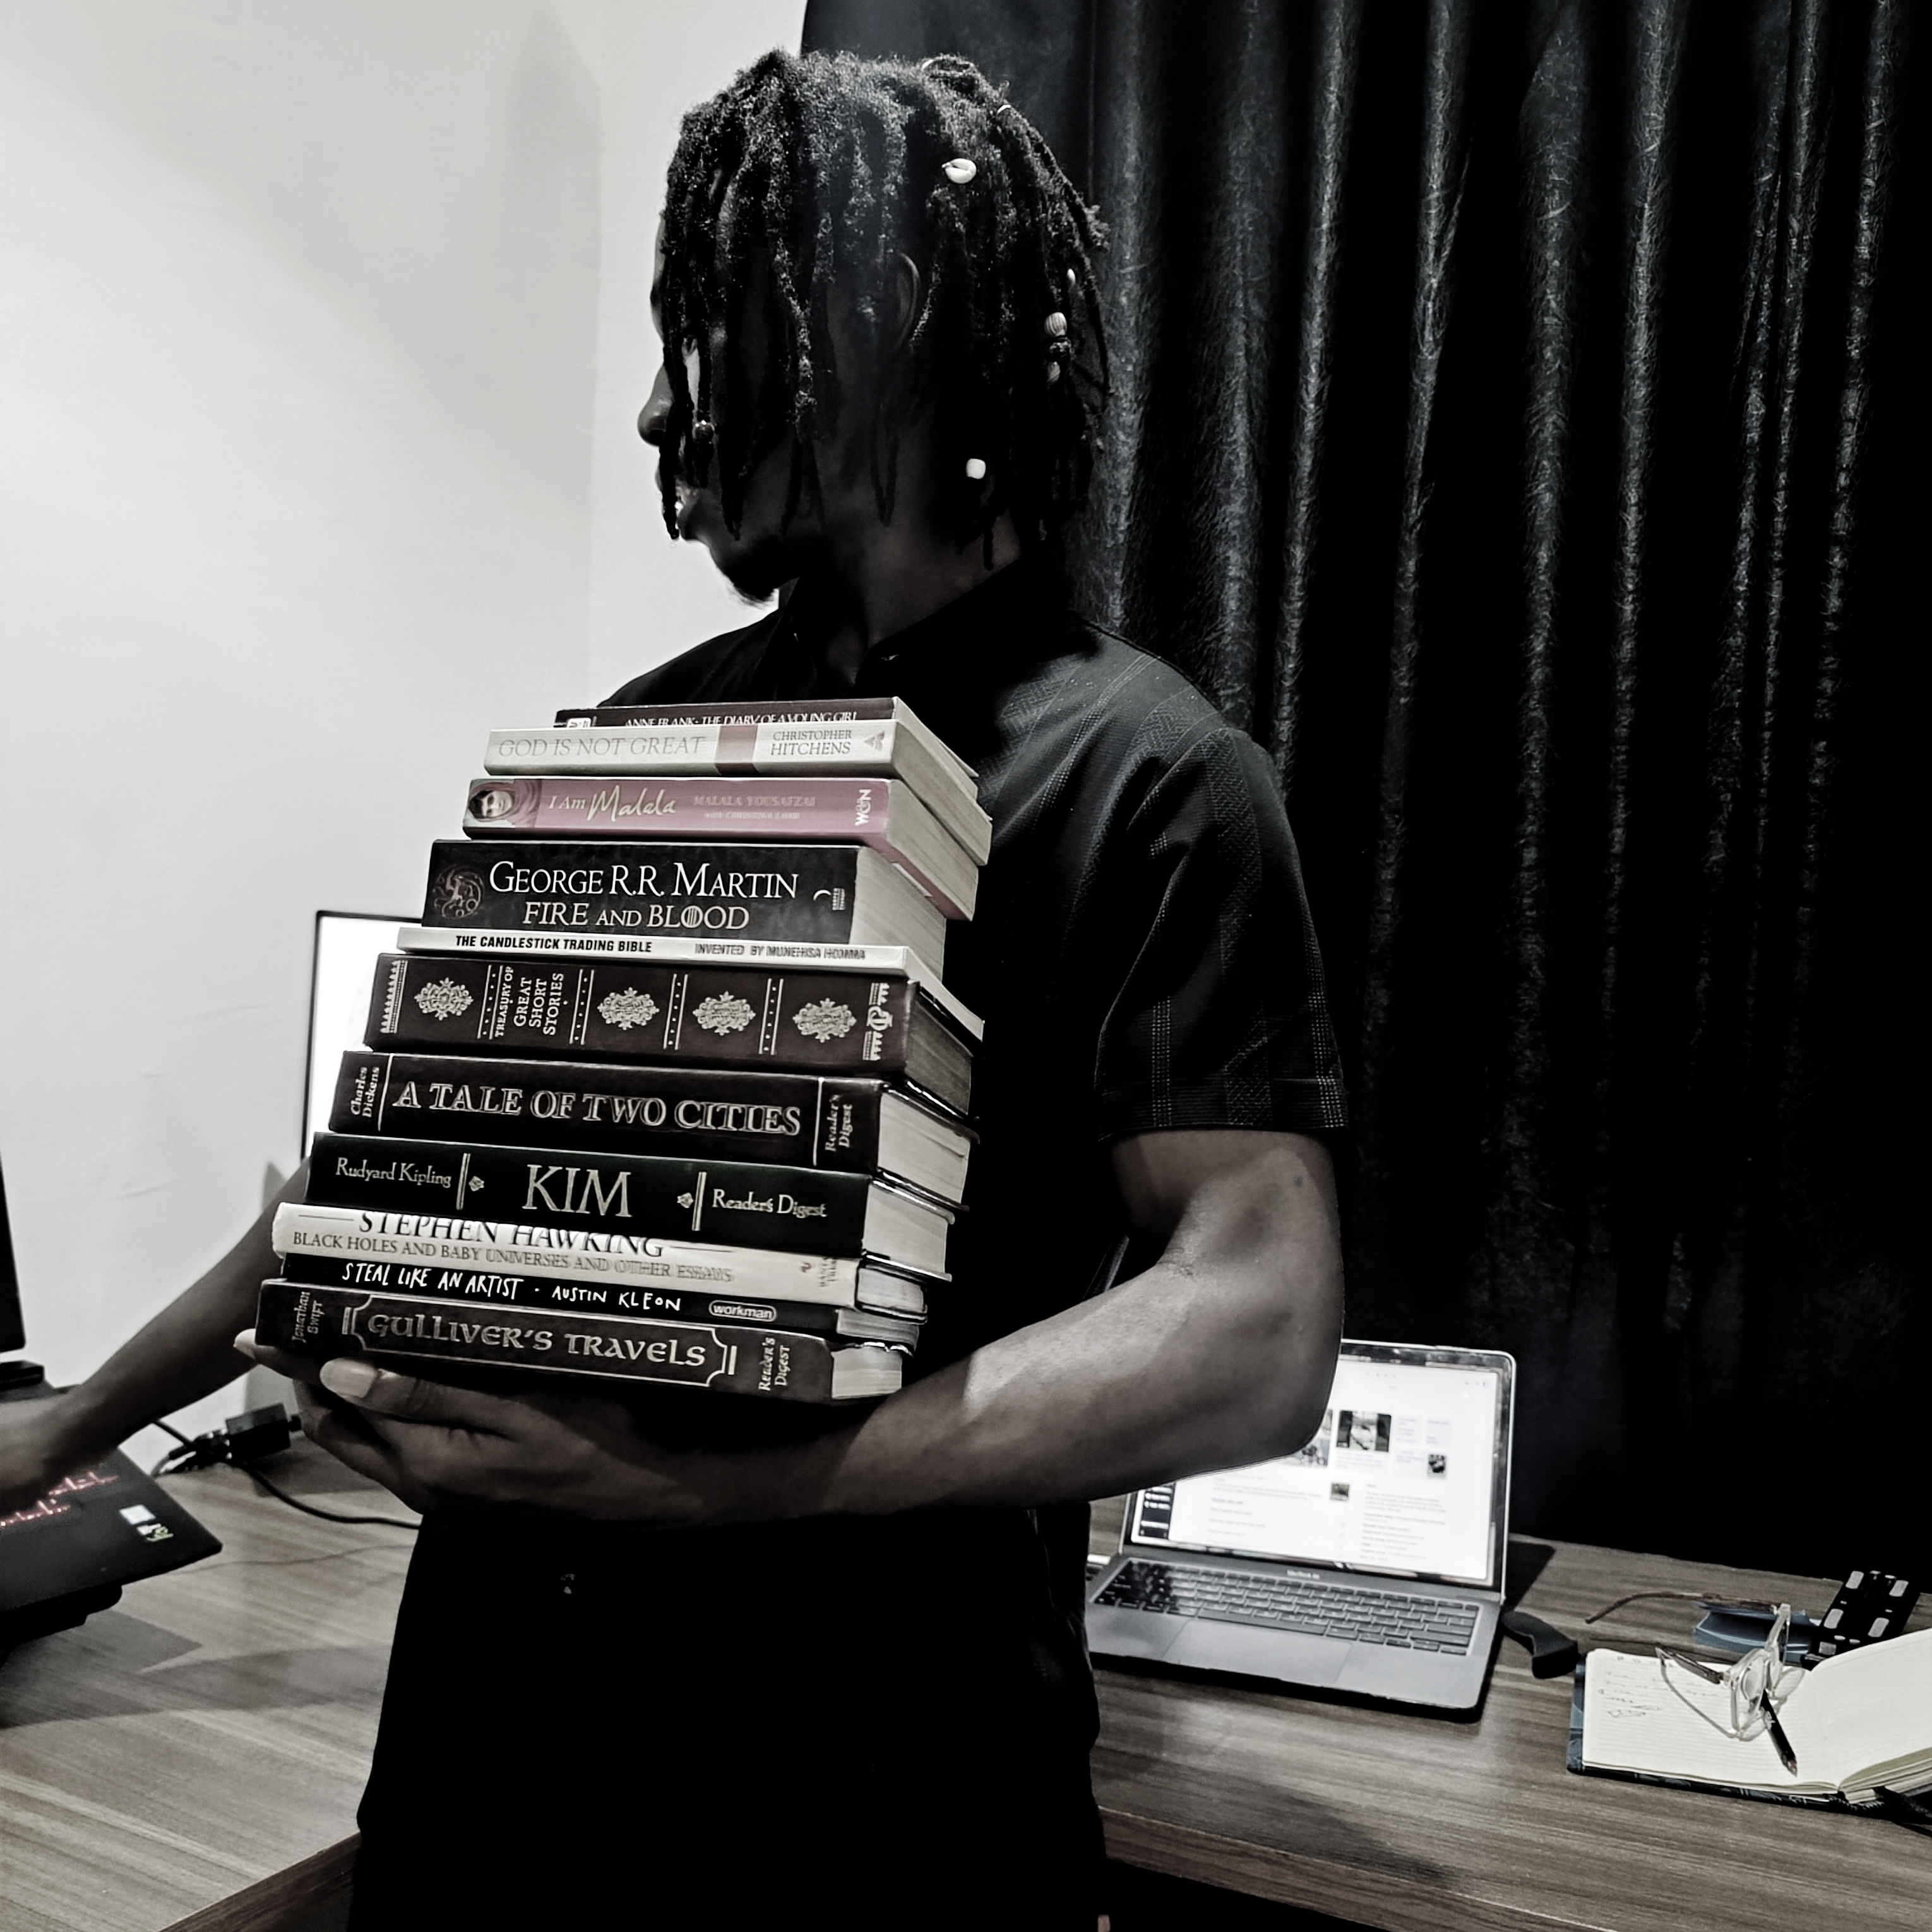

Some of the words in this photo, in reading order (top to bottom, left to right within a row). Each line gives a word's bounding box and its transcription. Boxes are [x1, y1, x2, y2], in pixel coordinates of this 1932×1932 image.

[499, 738, 547, 756] GOD
[553, 738, 571, 756] IS
[576, 737, 626, 756] NOT
[629, 736, 705, 755] GREAT
[770, 741, 852, 756] HITCHENS
[772, 729, 852, 741] CHRISTOPHER
[548, 795, 558, 809] I
[558, 795, 586, 809] Am
[587, 784, 677, 821] Malala
[694, 796, 743, 806] MALALA
[489, 861, 604, 894] GEORGE
[671, 862, 799, 899] MARTIN
[522, 901, 590, 926] FIRE
[595, 910, 642, 927] AND
[646, 904, 750, 930] BLOOD
[456, 935, 477, 946] THE
[480, 936, 560, 950] CANDLESTICK
[563, 938, 614, 951] TRADING
[617, 940, 652, 953] BIBLE
[695, 943, 745, 955] INVENTED
[750, 945, 764, 956] BY
[494, 983, 513, 1038] TREASURY
[505, 966, 514, 982] OF
[513, 977, 532, 1027] GREAT
[528, 978, 547, 1029] SHORT
[543, 972, 564, 1036] STORIES
[350, 1066, 368, 1116] Charles
[362, 1066, 379, 1118] Dickens
[392, 1080, 422, 1108] A
[429, 1083, 523, 1115] TALE
[530, 1090, 576, 1119] OF
[581, 1092, 667, 1126] TWO
[674, 1099, 801, 1136] CITIES
[838, 1104, 853, 1148] Digest
[335, 1157, 397, 1182] Rudyard
[399, 1163, 452, 1188] Kipling
[522, 1164, 633, 1217] KIM
[712, 1188, 774, 1213] Reader's
[777, 1193, 828, 1219] Digest
[359, 1212, 498, 1243] STEPHEN
[509, 1225, 664, 1258] HAWKING
[293, 1232, 343, 1249] BLACK
[347, 1236, 397, 1253] HOLES
[401, 1242, 436, 1257] AND
[441, 1245, 482, 1261] BABY
[486, 1248, 569, 1268] UNIVERSES
[573, 1256, 609, 1272] AND
[614, 1260, 671, 1277] OTHER
[342, 1263, 390, 1285] STEAL
[398, 1267, 432, 1289] LIKE
[438, 1272, 463, 1291] AN
[465, 1274, 524, 1300] ARTIST
[552, 1285, 607, 1303] AUSTIN
[618, 1292, 681, 1311] KLEON
[713, 1303, 773, 1320] workman
[564, 1333, 706, 1367] TRAVELS
